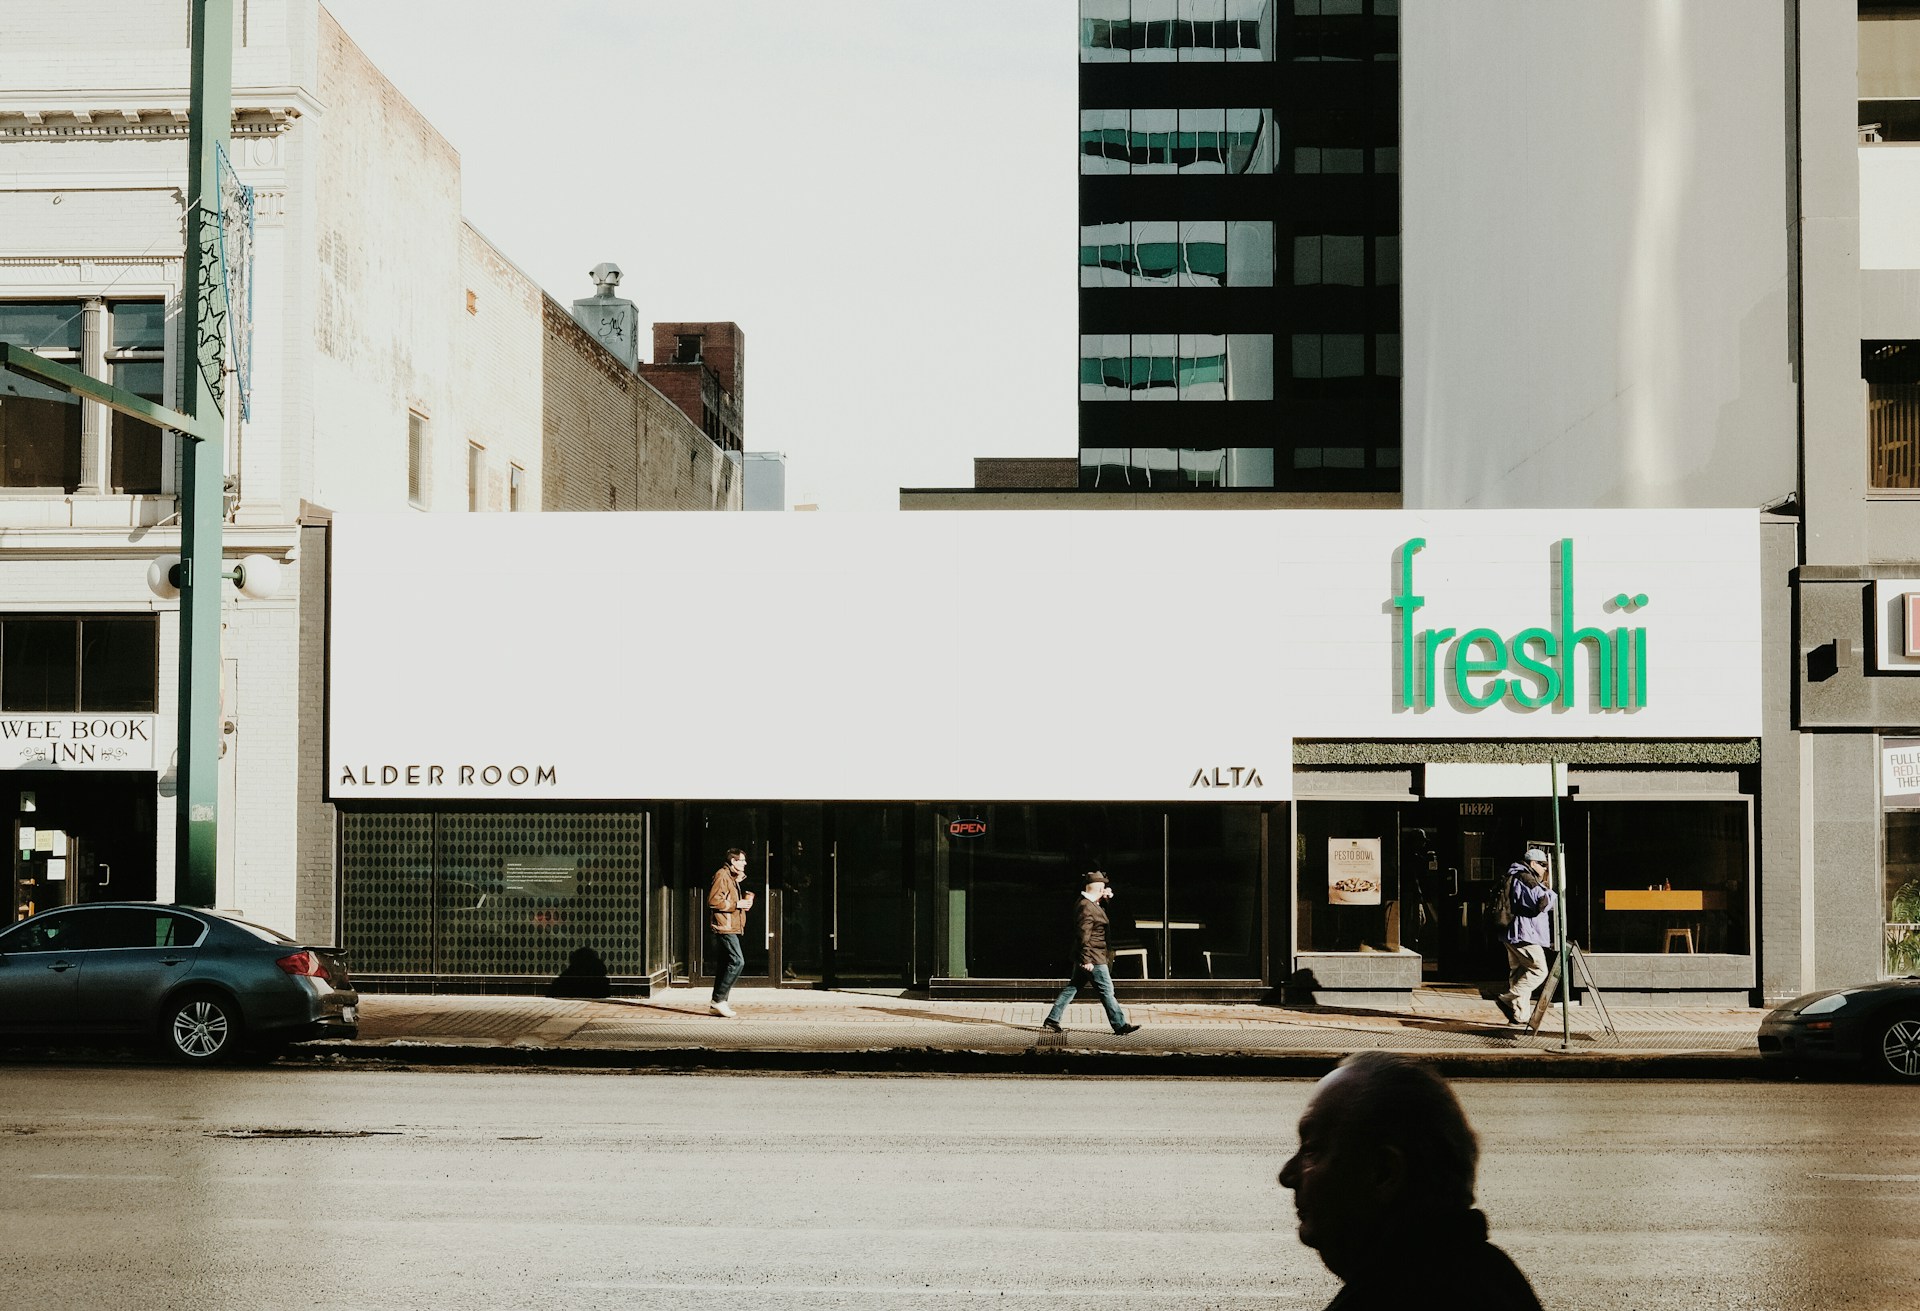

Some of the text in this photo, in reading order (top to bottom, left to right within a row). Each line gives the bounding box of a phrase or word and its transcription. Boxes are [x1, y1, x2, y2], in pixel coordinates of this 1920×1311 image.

[1393, 537, 1649, 709] freshii
[0, 719, 150, 741] WEE BOOK
[51, 742, 96, 765] INN
[1890, 753, 1916, 766] FULL
[341, 764, 557, 786] ALDER ROOM
[1190, 766, 1264, 788] ALTA
[1893, 765, 1914, 777] RED
[1461, 803, 1493, 815] 10322
[950, 823, 987, 833] OPEN
[1334, 850, 1375, 861] PESTO BOWL
